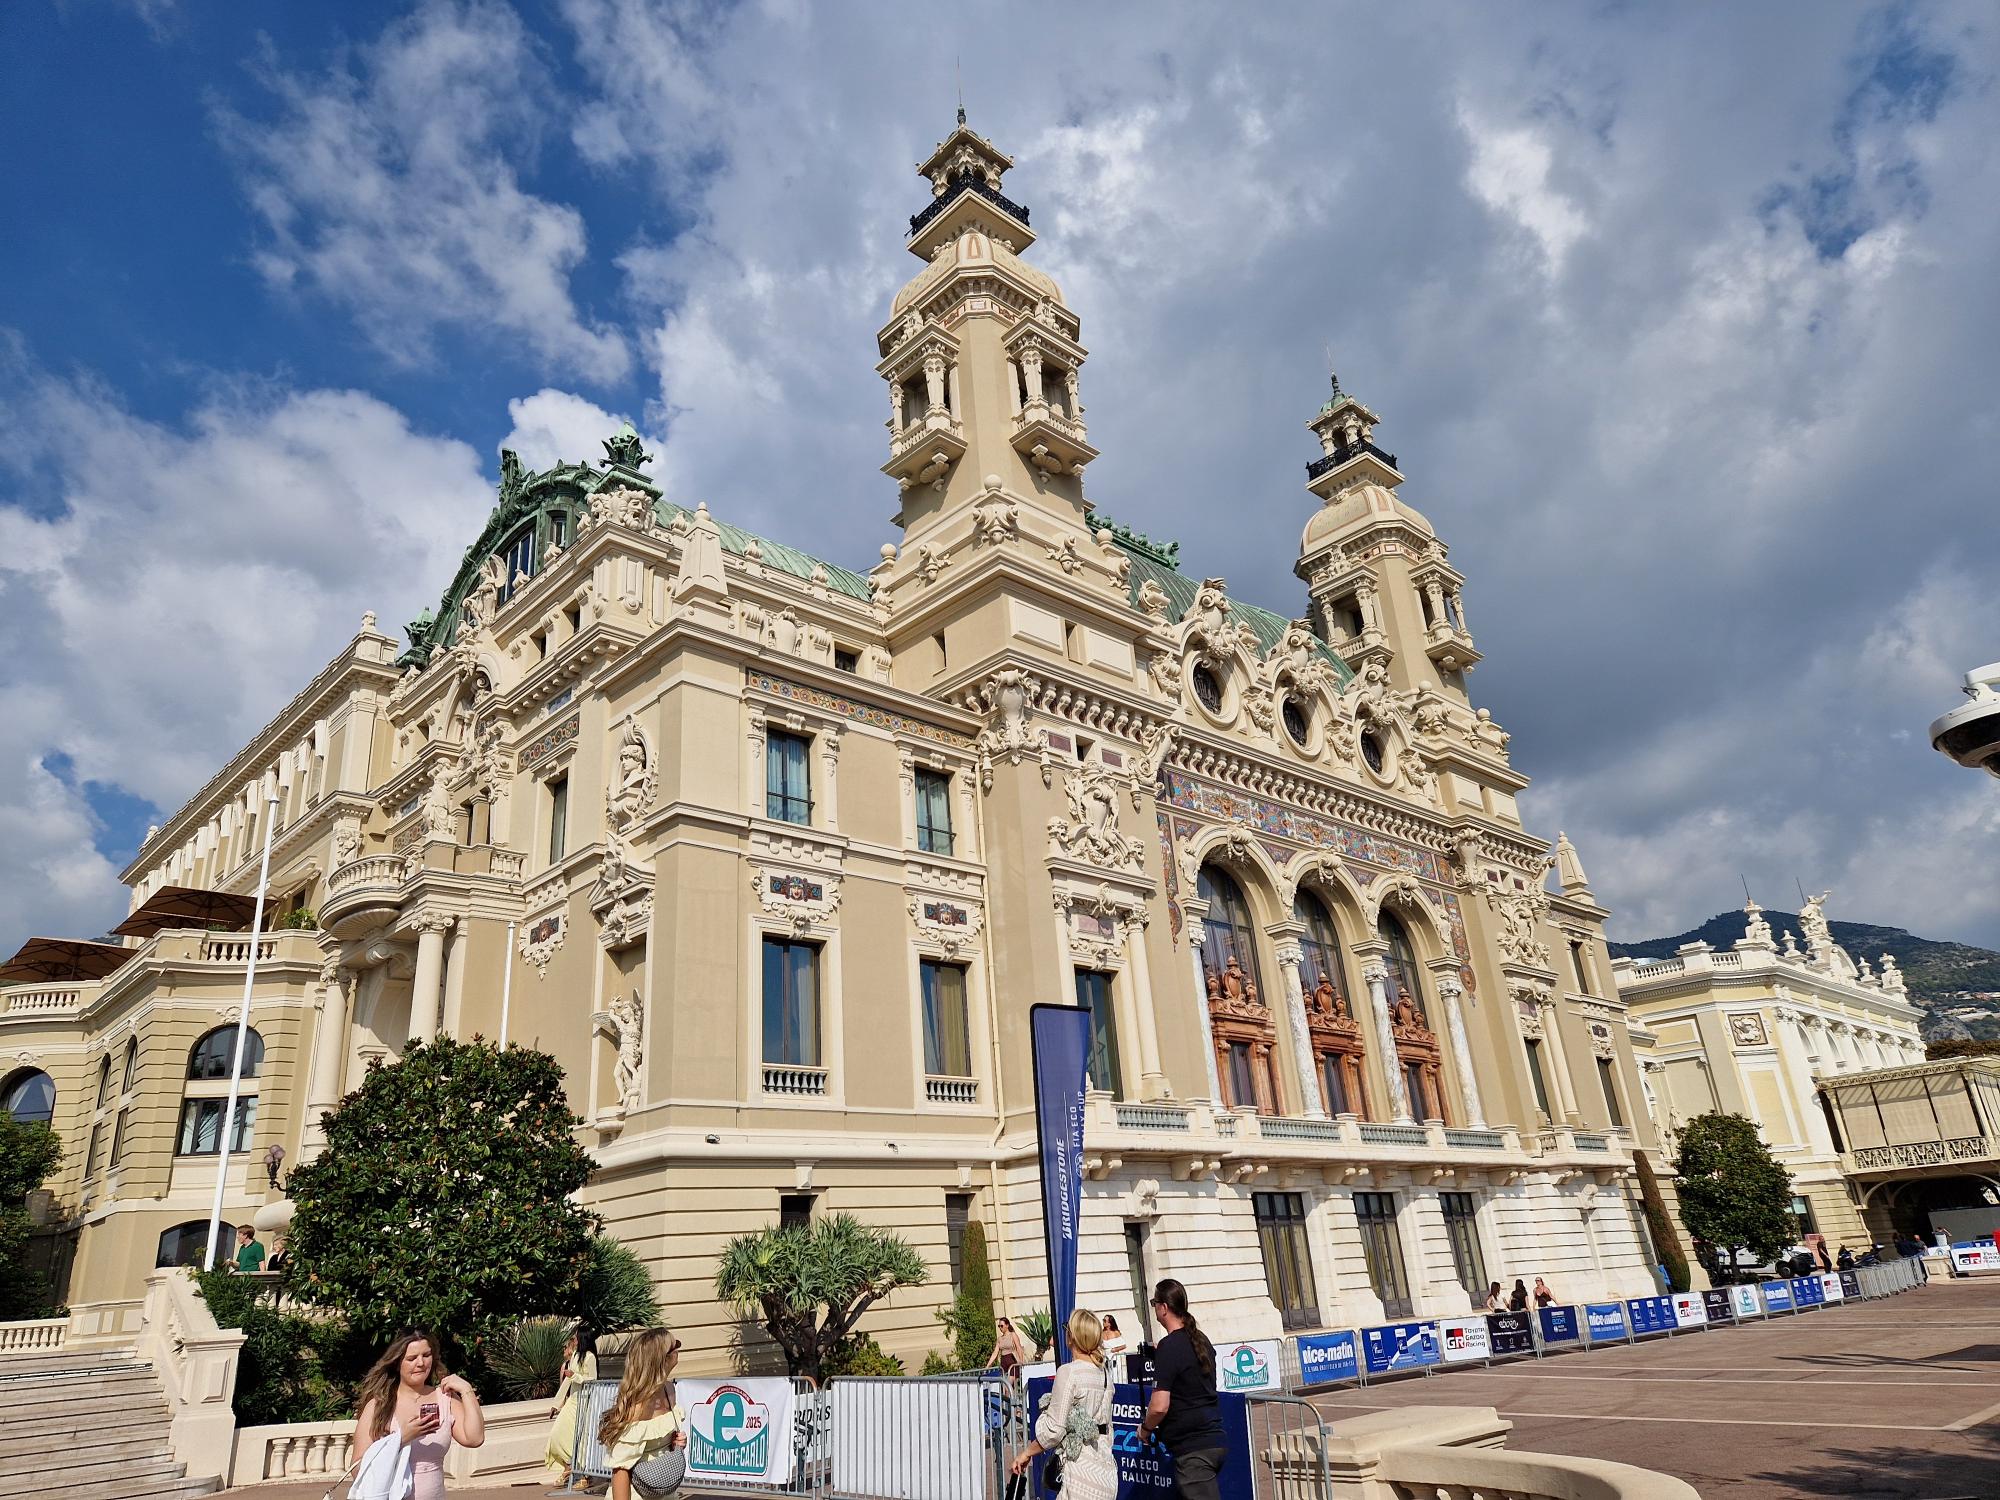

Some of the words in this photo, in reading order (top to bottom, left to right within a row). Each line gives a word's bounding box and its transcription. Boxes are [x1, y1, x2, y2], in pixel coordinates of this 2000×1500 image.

[1077, 1091, 1085, 1112] CUP
[1070, 1106, 1079, 1127] ECO
[1073, 1131, 1081, 1148] FIA
[1056, 1137, 1073, 1240] BRIDGESTONE
[1302, 1341, 1354, 1365] nice-matin
[1447, 1336, 1465, 1350] GR
[1236, 1349, 1255, 1377] e
[714, 1393, 745, 1449] e
[745, 1416, 762, 1429] 2025
[692, 1432, 713, 1464] RALLYE
[715, 1434, 765, 1468] MONTE-CARLO
[1121, 1457, 1137, 1468] FIA
[1140, 1460, 1159, 1471] ECO
[1122, 1472, 1150, 1484] RALLY
[1154, 1475, 1172, 1488] CUP
